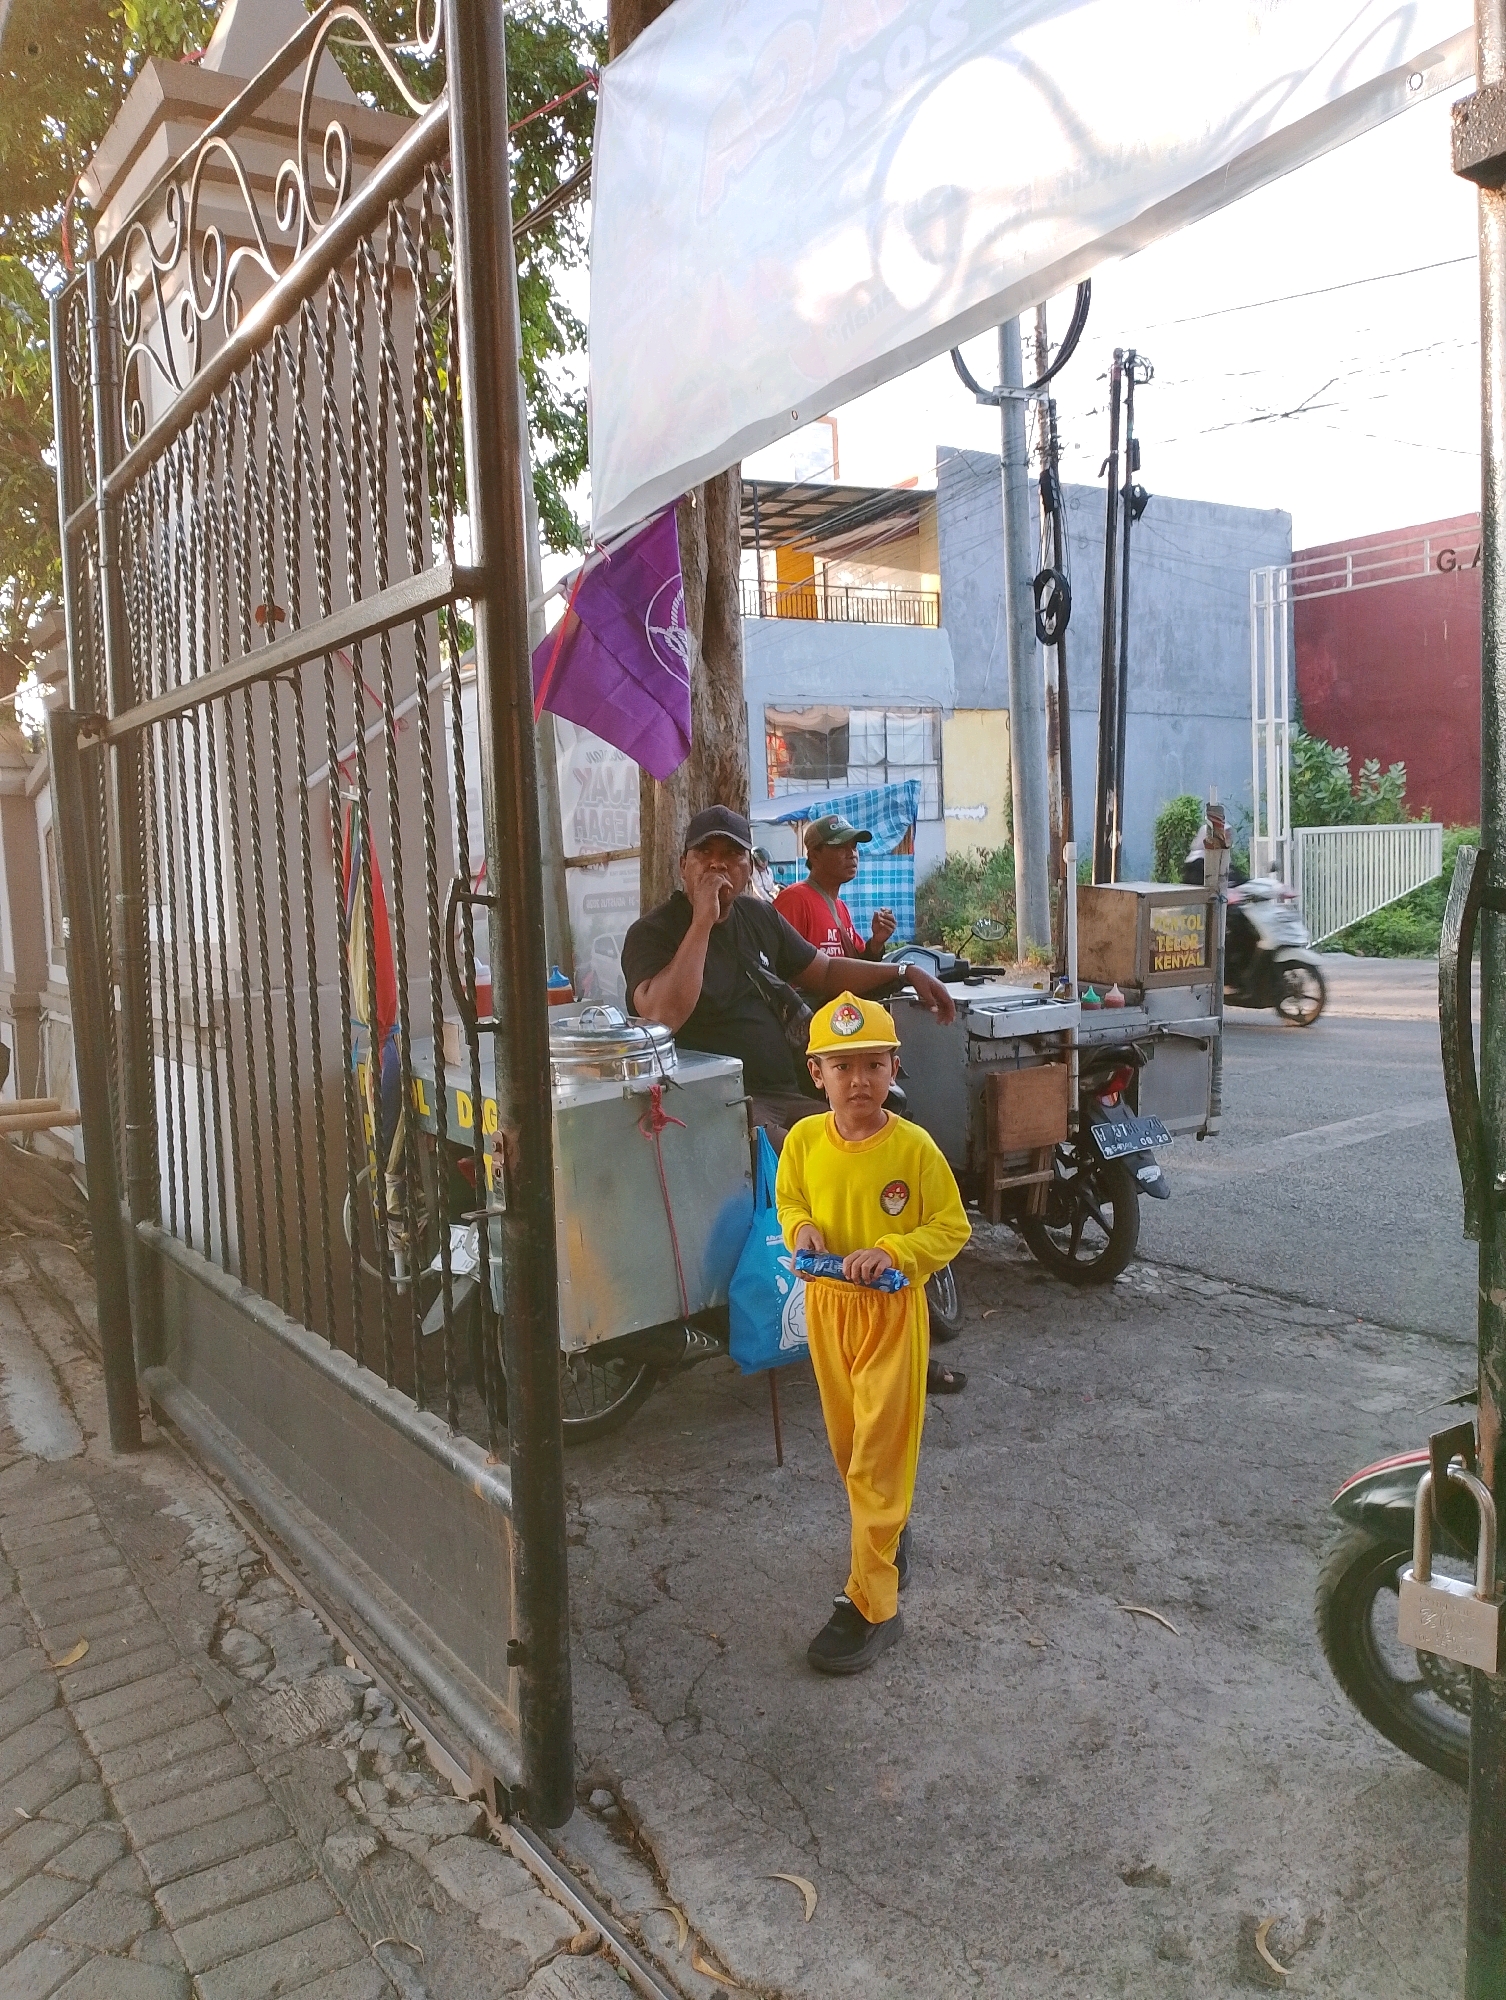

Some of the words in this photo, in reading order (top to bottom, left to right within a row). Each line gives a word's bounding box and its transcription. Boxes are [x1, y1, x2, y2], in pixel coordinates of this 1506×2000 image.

[1153, 913, 1205, 931] PENTOL
[1156, 933, 1199, 952] TELOR
[1154, 952, 1205, 971] KENYAL
